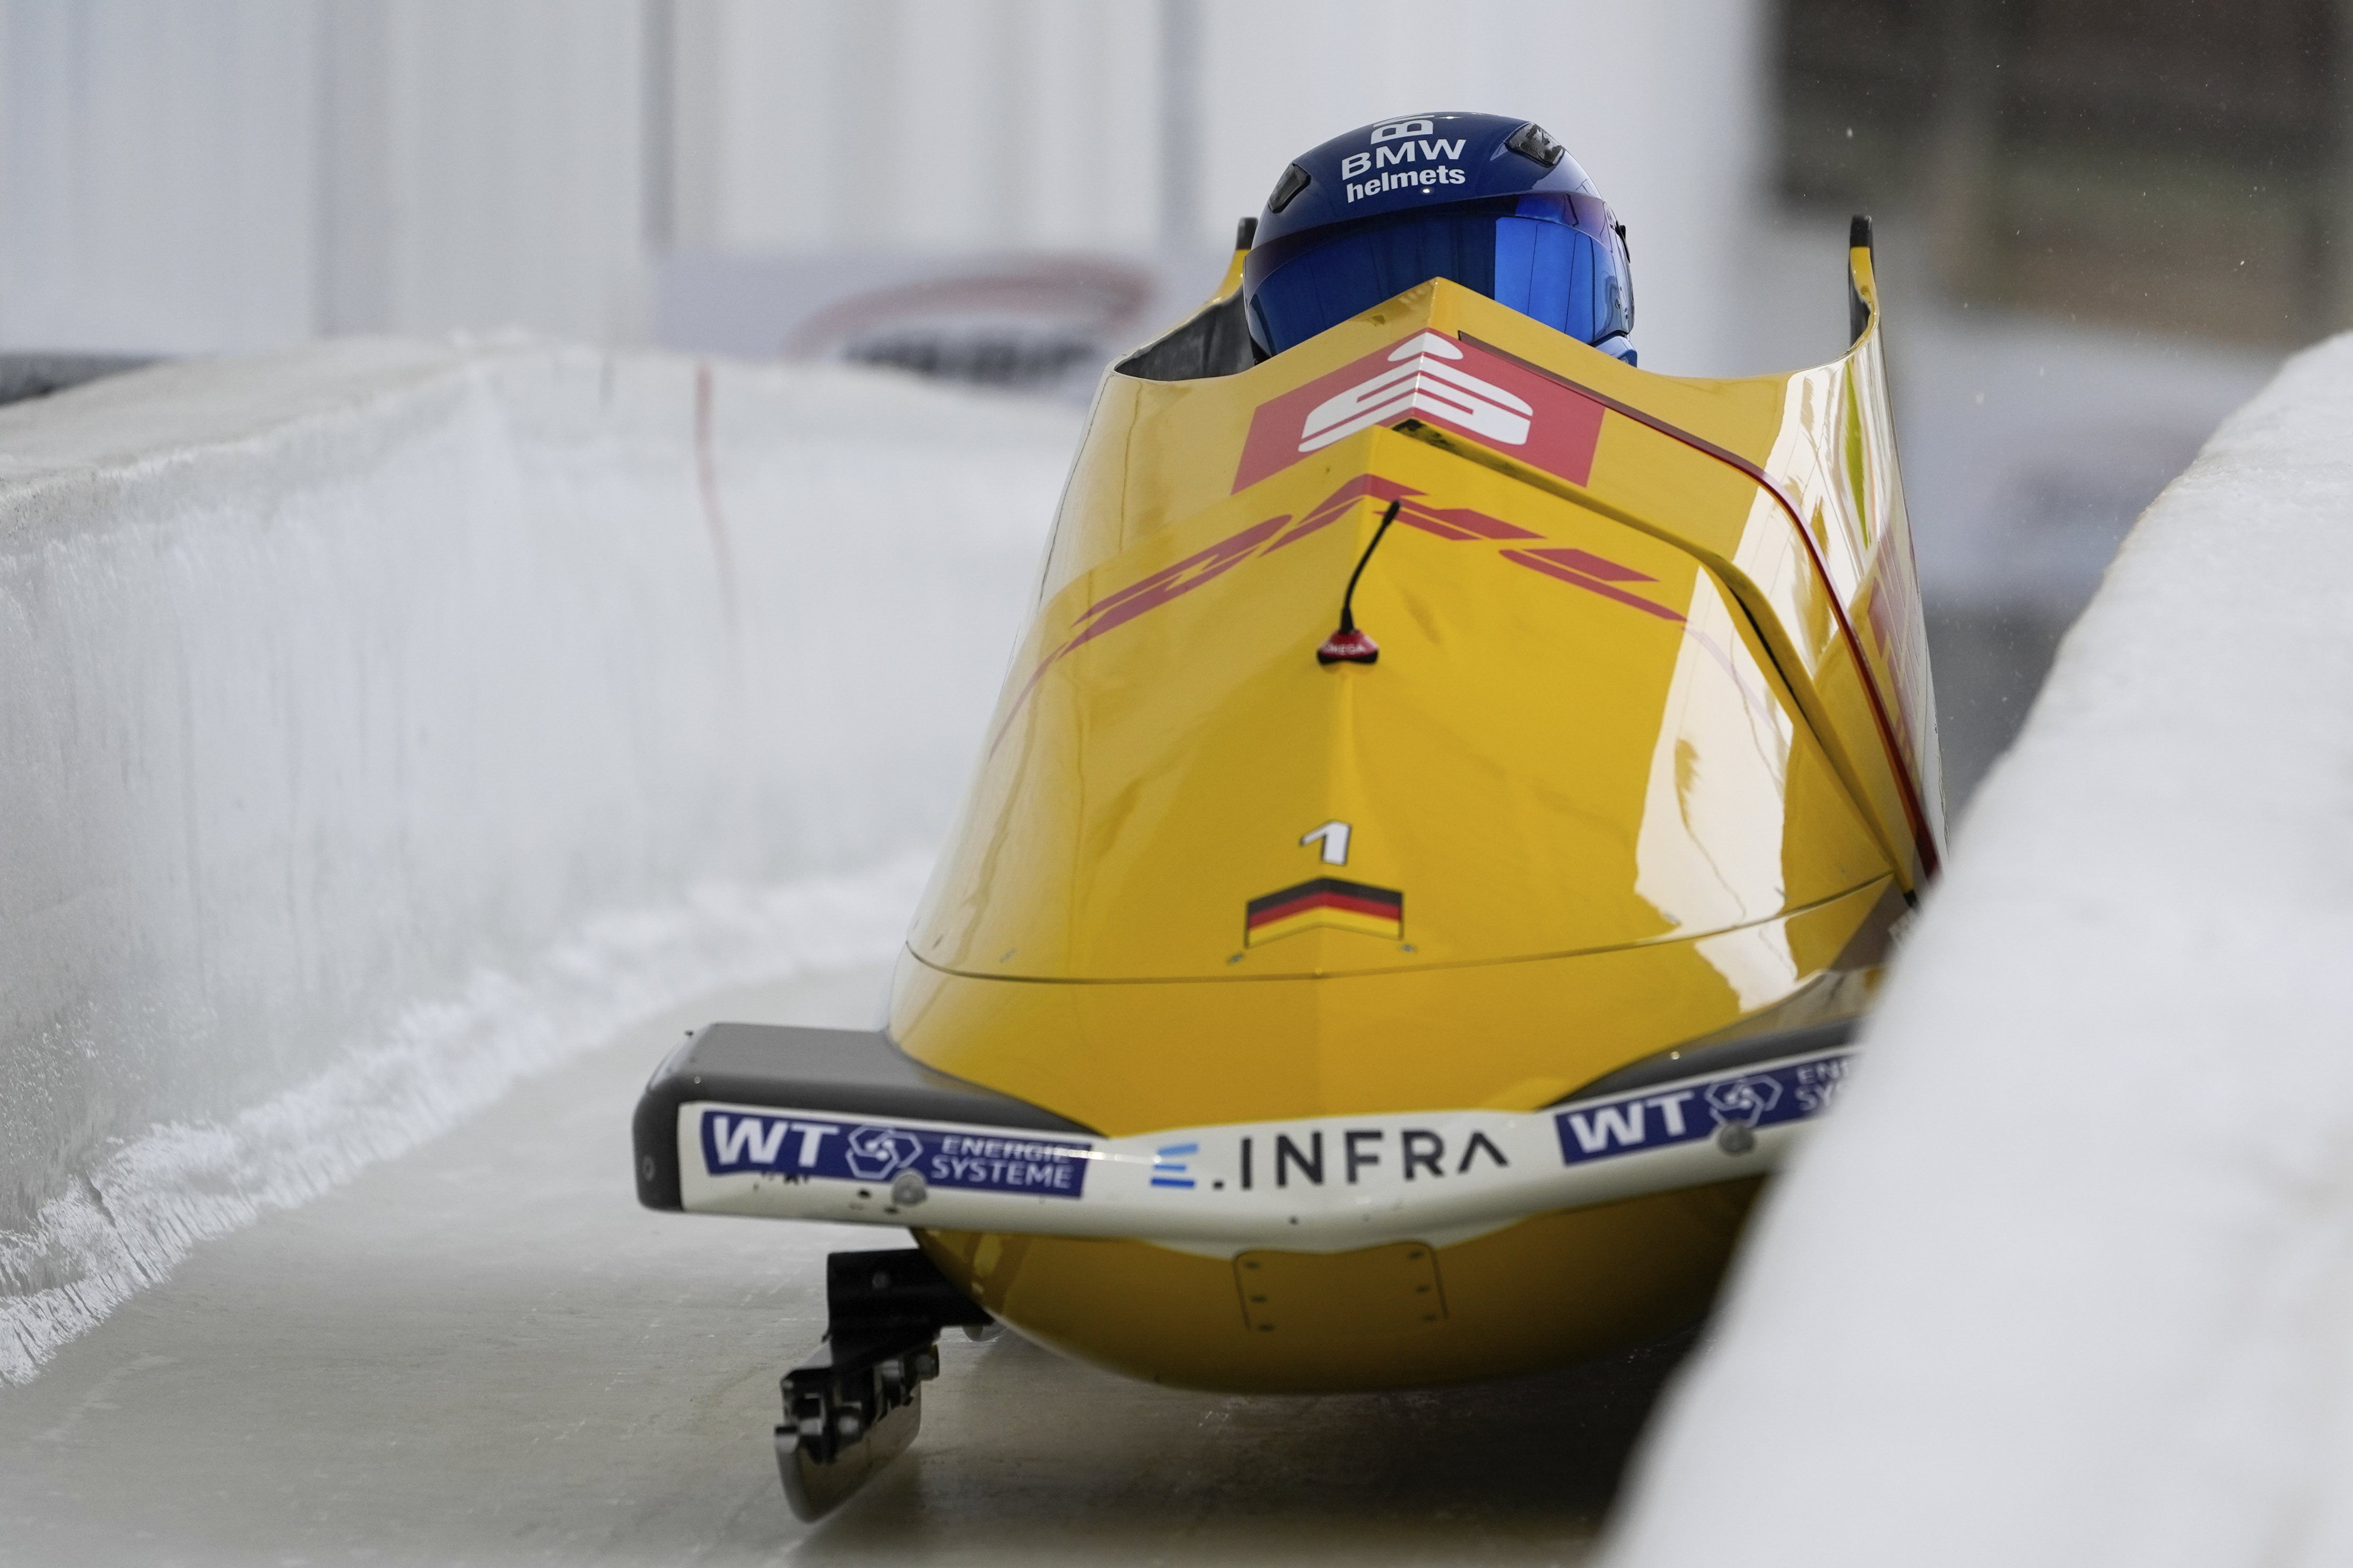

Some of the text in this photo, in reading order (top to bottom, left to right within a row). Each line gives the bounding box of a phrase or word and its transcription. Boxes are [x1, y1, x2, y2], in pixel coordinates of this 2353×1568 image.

[1341, 139, 1467, 181] BMW
[1346, 165, 1466, 204] helmets
[1300, 820, 1352, 866] 1
[712, 1114, 840, 1168] WT
[1568, 1090, 1695, 1153] WT
[942, 1135, 1073, 1164] ENERGIE
[930, 1153, 1075, 1189] SYSTEME
